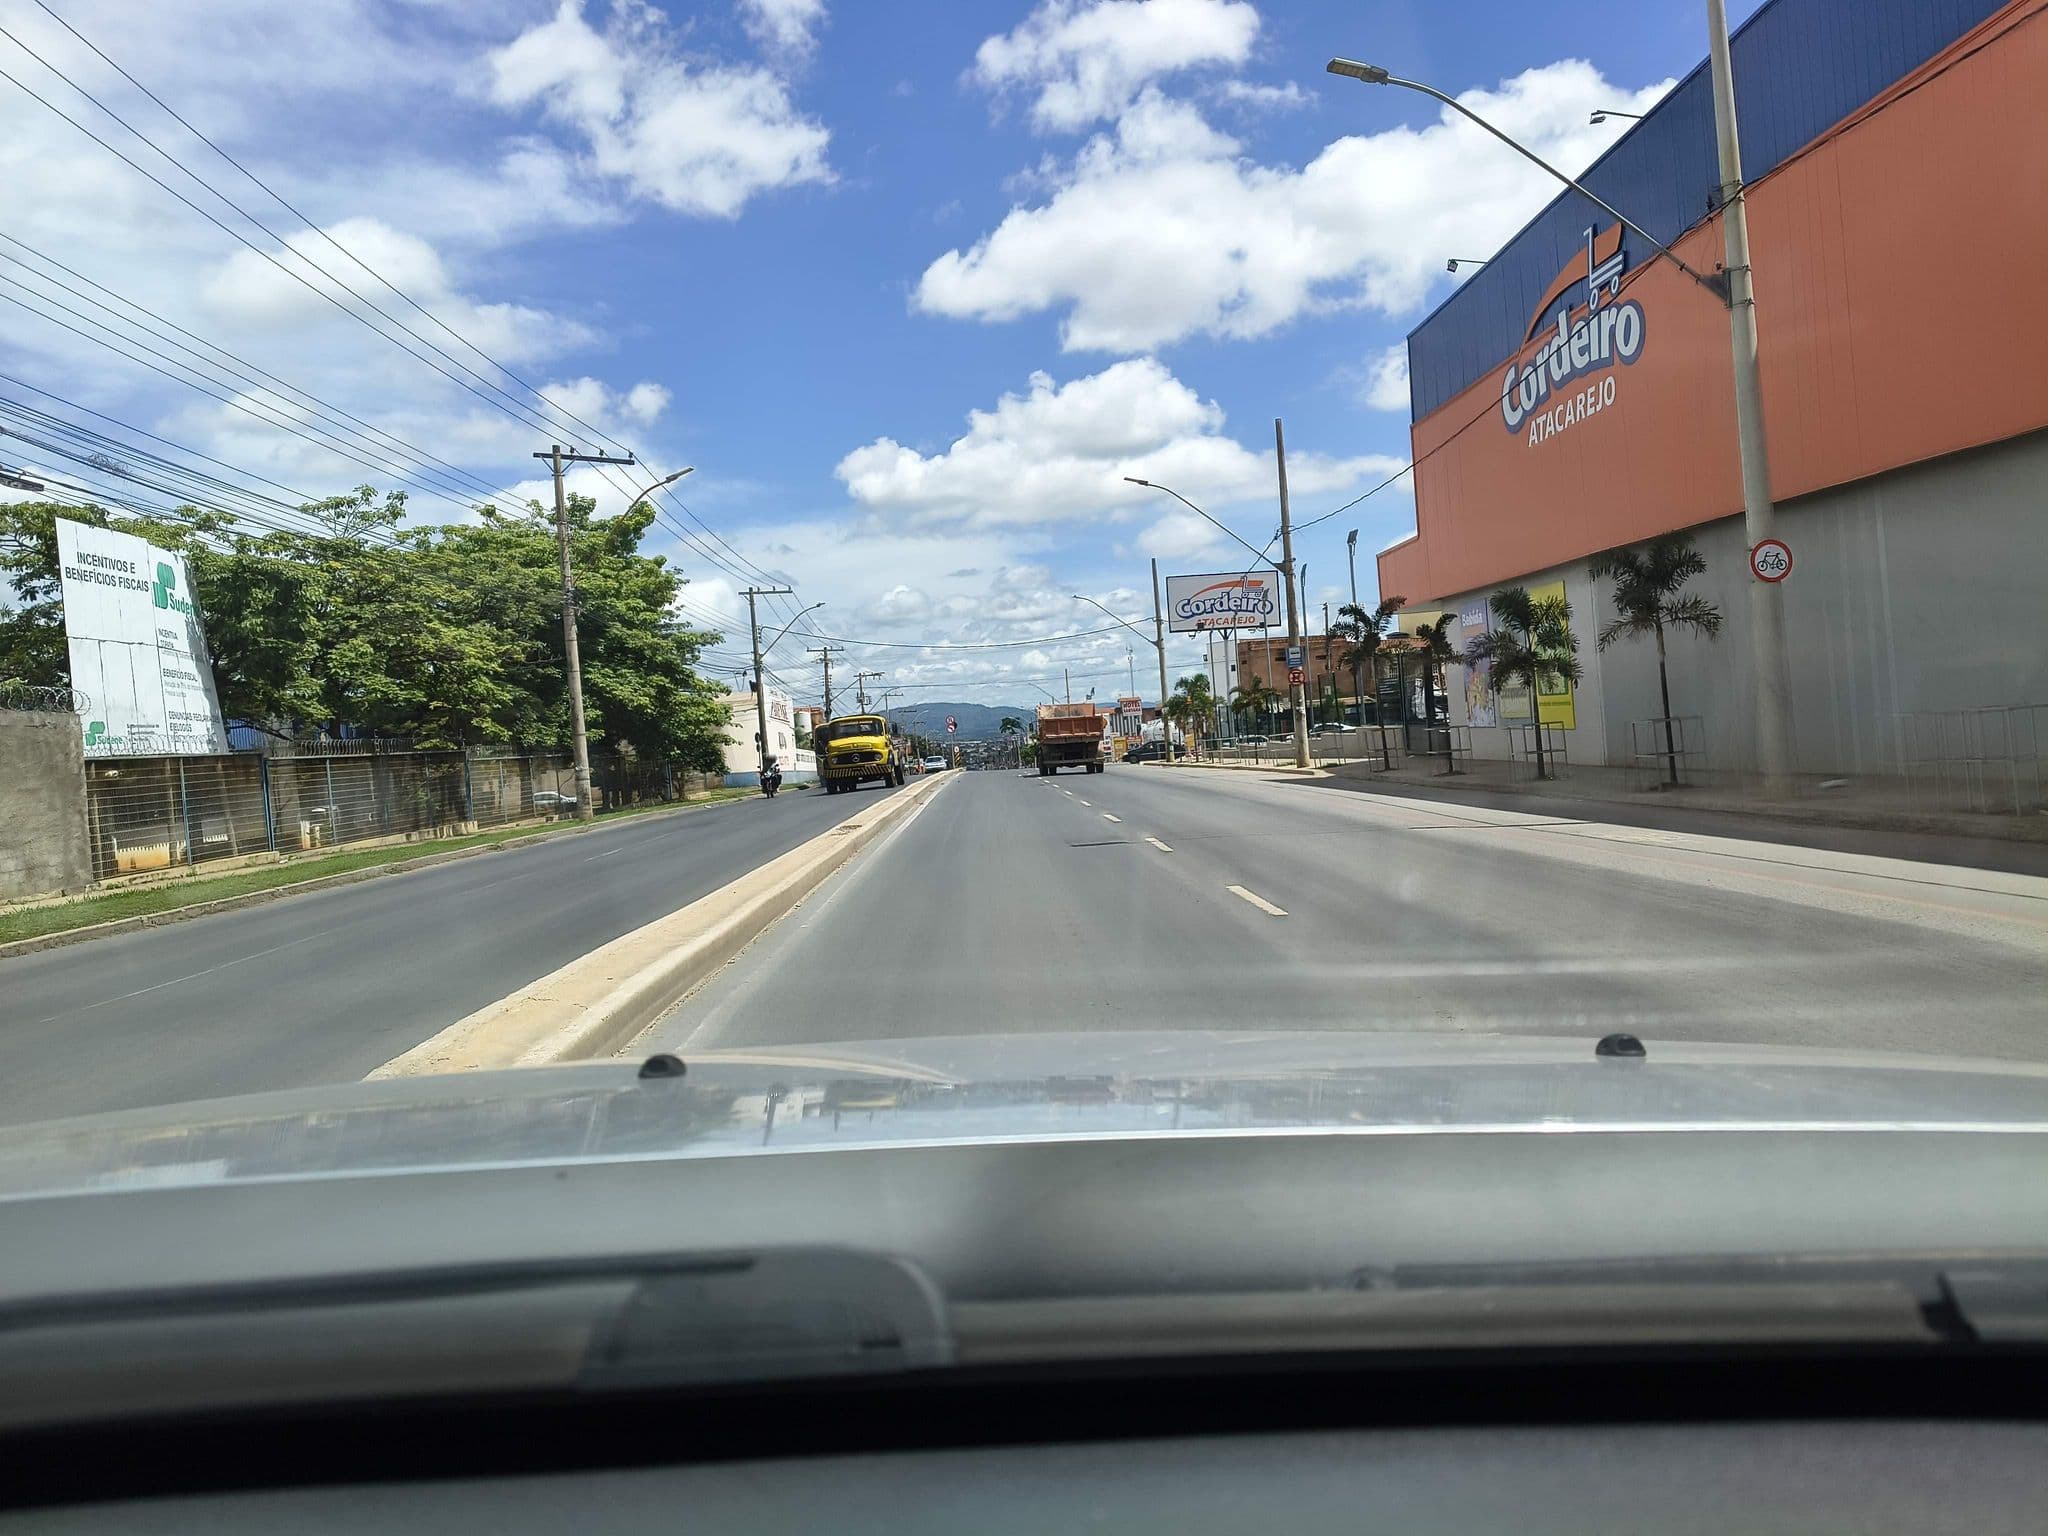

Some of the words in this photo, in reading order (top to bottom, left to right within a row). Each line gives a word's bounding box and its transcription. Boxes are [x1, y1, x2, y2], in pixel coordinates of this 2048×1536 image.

[1502, 304, 1641, 428] Cordeiro
[1528, 375, 1616, 448] ATACAREJO
[77, 551, 128, 573] INCENTIVOS
[130, 562, 136, 574] E
[65, 566, 117, 587] BENEFÍCIOS
[118, 576, 150, 592] FISCAIS
[1175, 592, 1274, 619] Cordeiro
